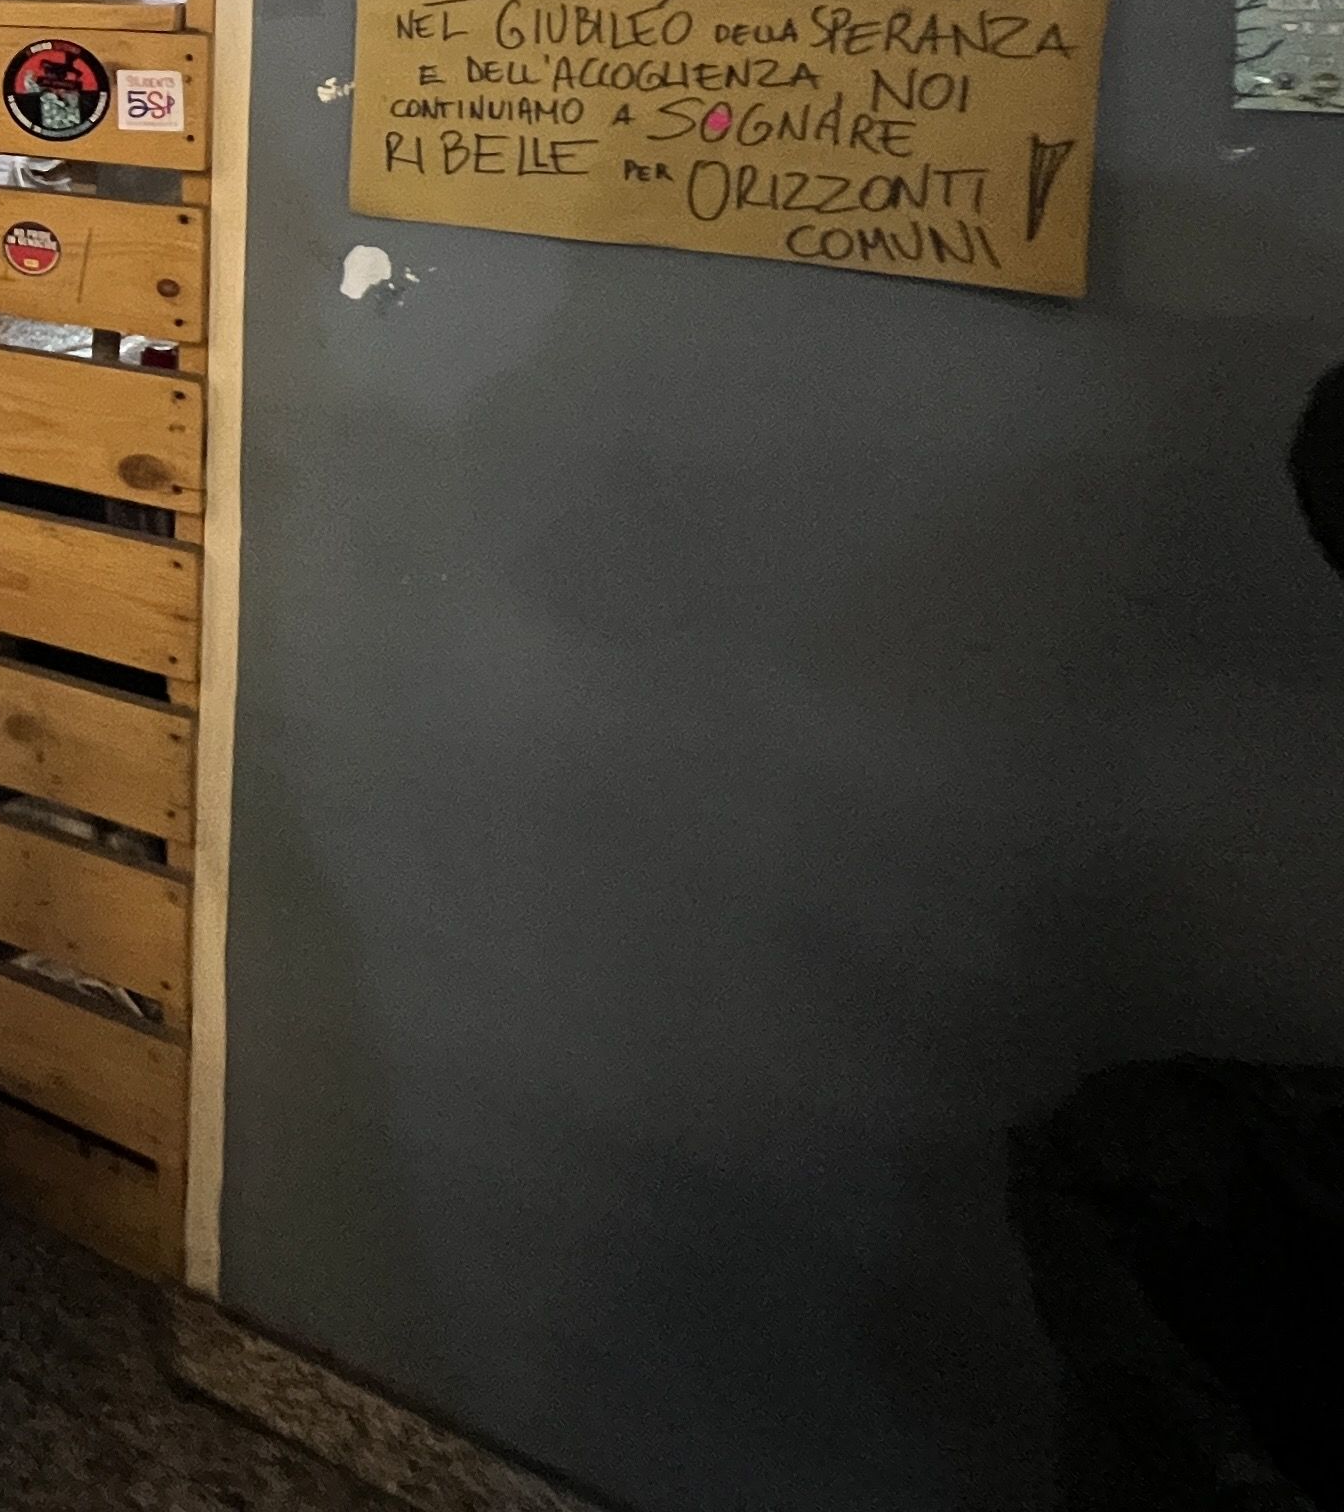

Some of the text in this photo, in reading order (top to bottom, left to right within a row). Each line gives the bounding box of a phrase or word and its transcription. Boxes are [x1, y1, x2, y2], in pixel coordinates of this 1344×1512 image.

[397, 9, 468, 42] NEL
[715, 18, 799, 46] DELLA
[810, 5, 1079, 59] SPERANZA
[418, 54, 970, 114] E DELL'ACCOGLIENZA NOI
[390, 92, 917, 157] CONTINUIAMO A SOGNARE
[385, 131, 599, 176] RIBELLE
[623, 159, 674, 183] PER
[688, 159, 991, 221] ORIZZONTI
[786, 220, 1002, 270] COMUNI
